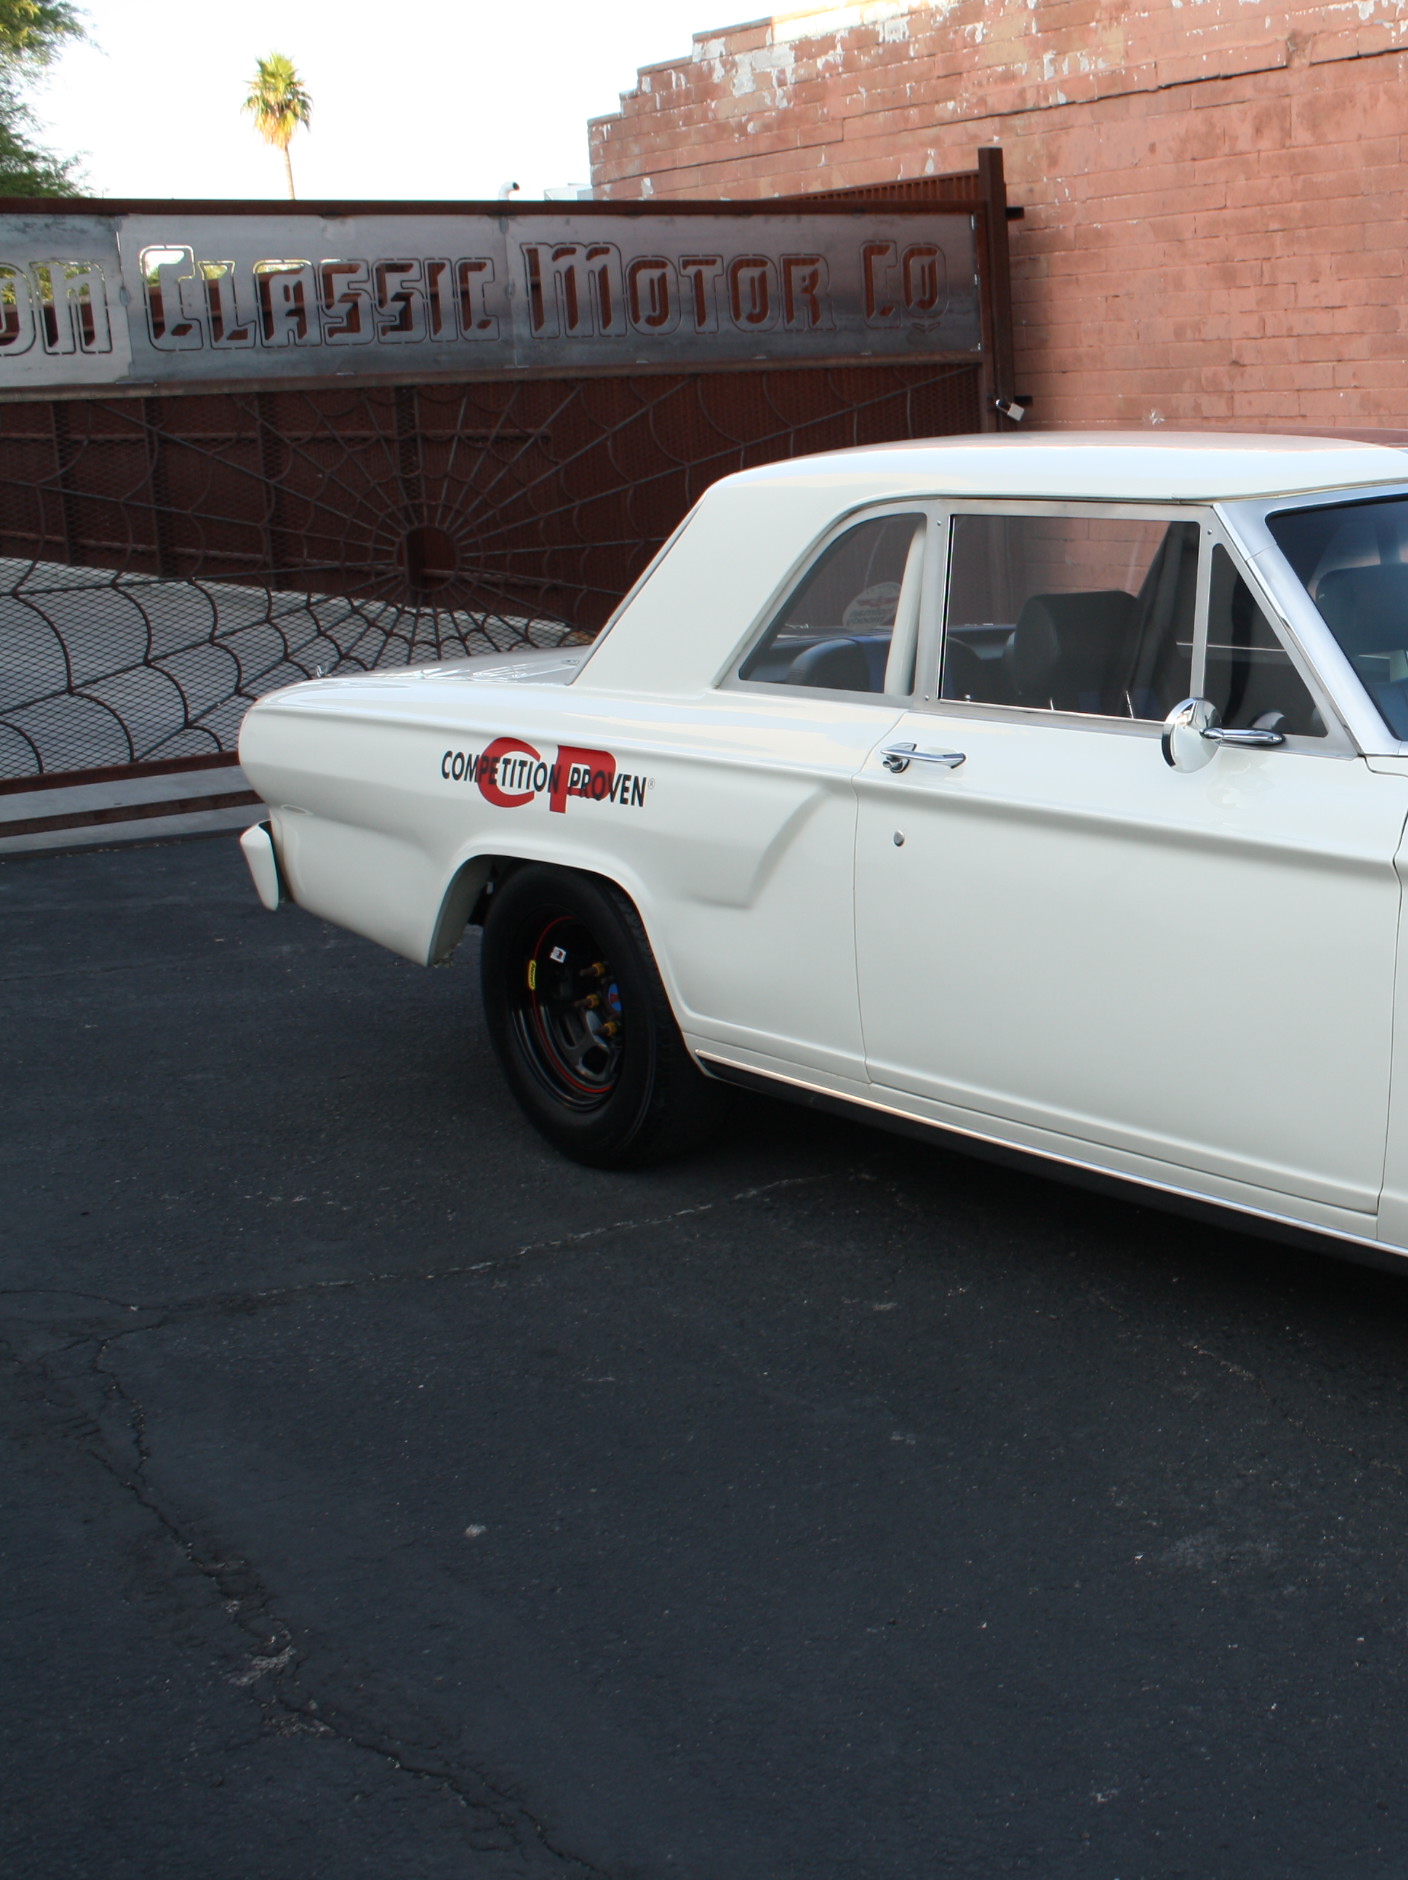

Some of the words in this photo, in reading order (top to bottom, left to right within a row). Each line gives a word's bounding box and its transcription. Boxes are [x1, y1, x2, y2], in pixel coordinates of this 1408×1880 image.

[139, 245, 500, 351] CLASSIC
[519, 242, 836, 338] MOTOR
[860, 240, 949, 331] CO
[441, 750, 560, 794] COMPETITION
[567, 767, 647, 807] PROVEN
